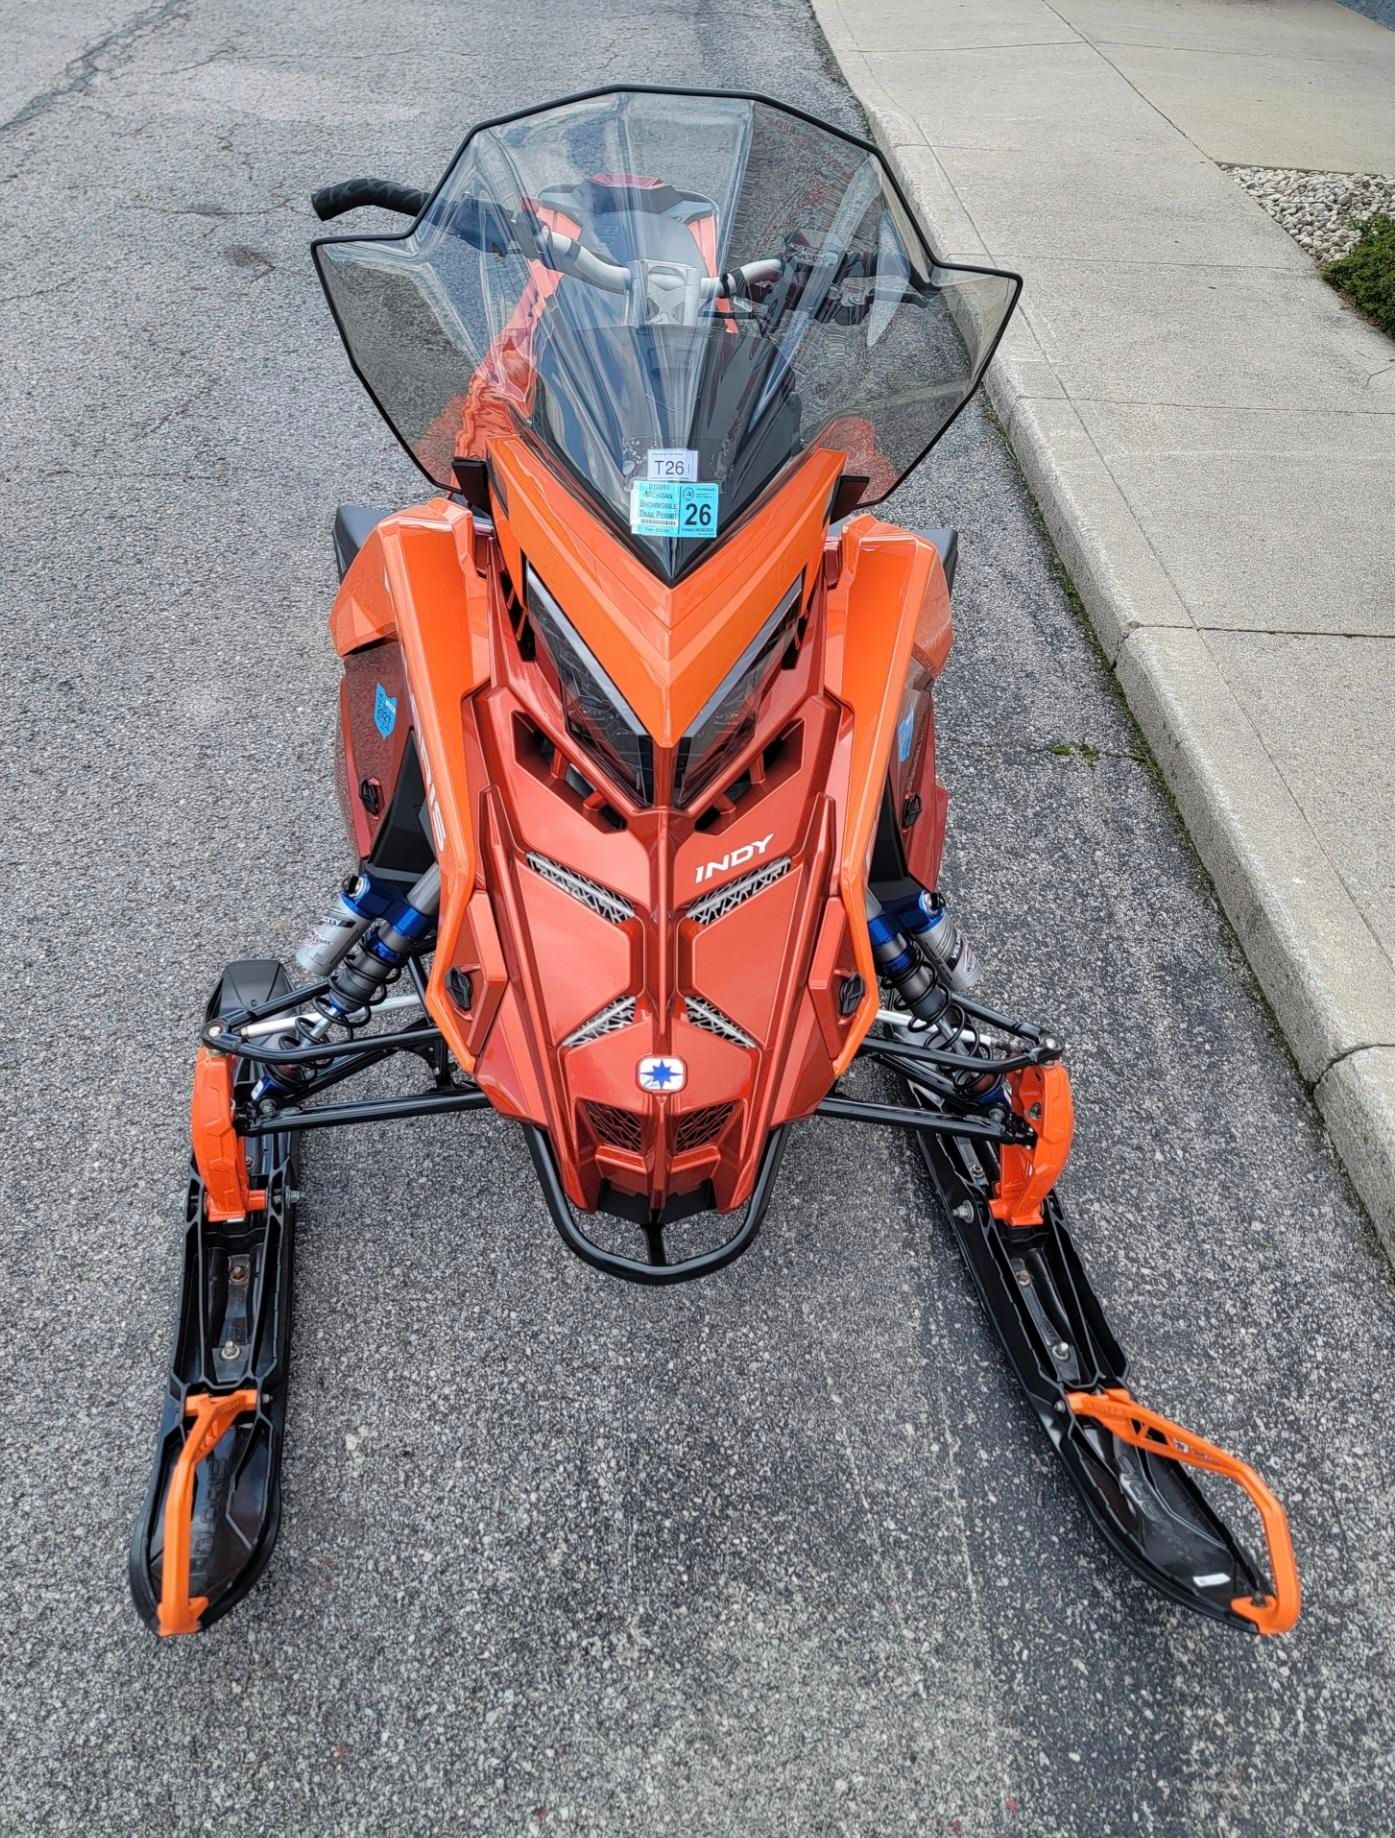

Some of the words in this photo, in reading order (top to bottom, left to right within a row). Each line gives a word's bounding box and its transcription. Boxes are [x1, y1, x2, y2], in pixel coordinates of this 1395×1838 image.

[653, 460, 685, 475] T26
[684, 502, 712, 526] 26
[695, 833, 774, 883] INDY
